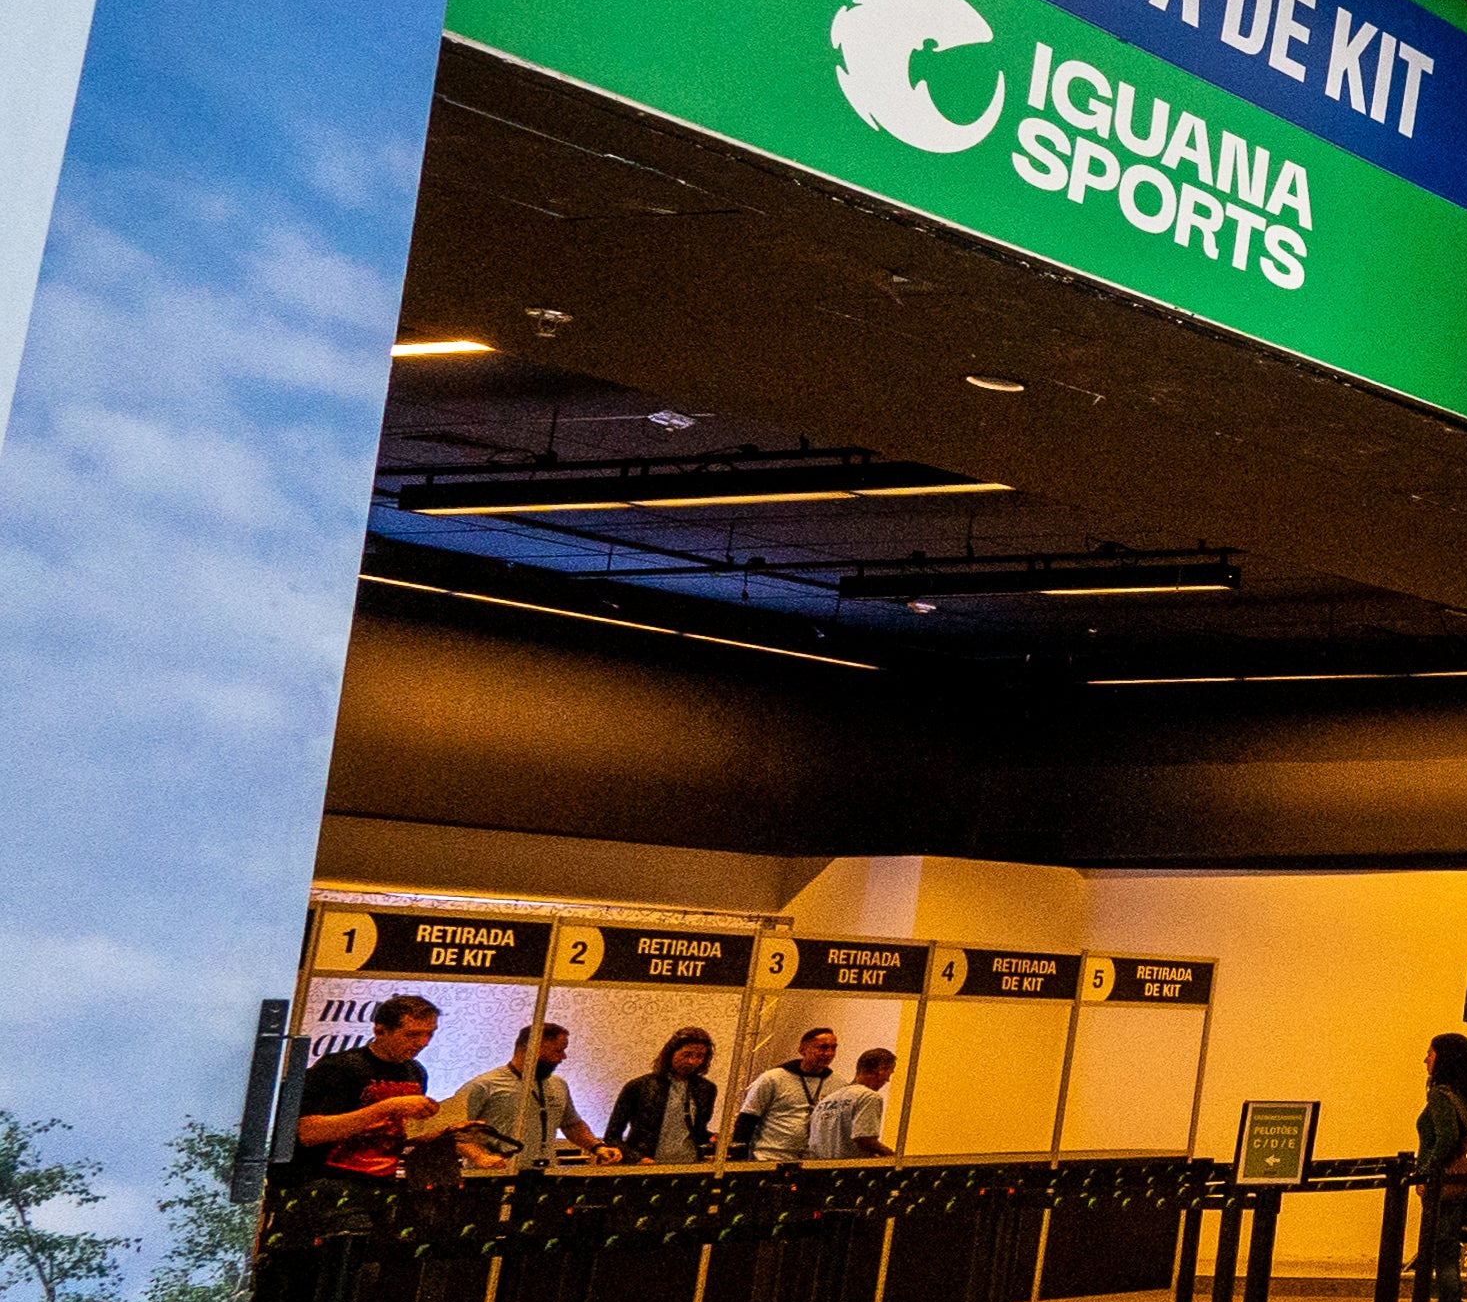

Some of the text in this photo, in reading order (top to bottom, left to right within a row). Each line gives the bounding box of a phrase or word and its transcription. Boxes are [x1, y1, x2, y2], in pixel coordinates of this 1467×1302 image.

[1323, 7, 1434, 140] KIT
[1027, 42, 1314, 232] IGUANA
[1011, 117, 1307, 291] SPORTS
[342, 929, 357, 954] 1
[417, 924, 515, 947] RETIRADA
[430, 947, 496, 968] DE KIT
[569, 942, 588, 964] 2
[637, 938, 722, 959] RETIRADA
[649, 959, 706, 977] DE KIT
[769, 953, 785, 973] 3
[828, 949, 901, 968] RETIRADA
[992, 957, 1057, 975] RETIRADA
[838, 968, 887, 985] DE KIT
[940, 962, 956, 981] 4
[1092, 970, 1104, 989] 5
[1136, 965, 1193, 982] RETIRADA
[1022, 977, 1044, 992] KIT
[1163, 983, 1182, 998] KIT
